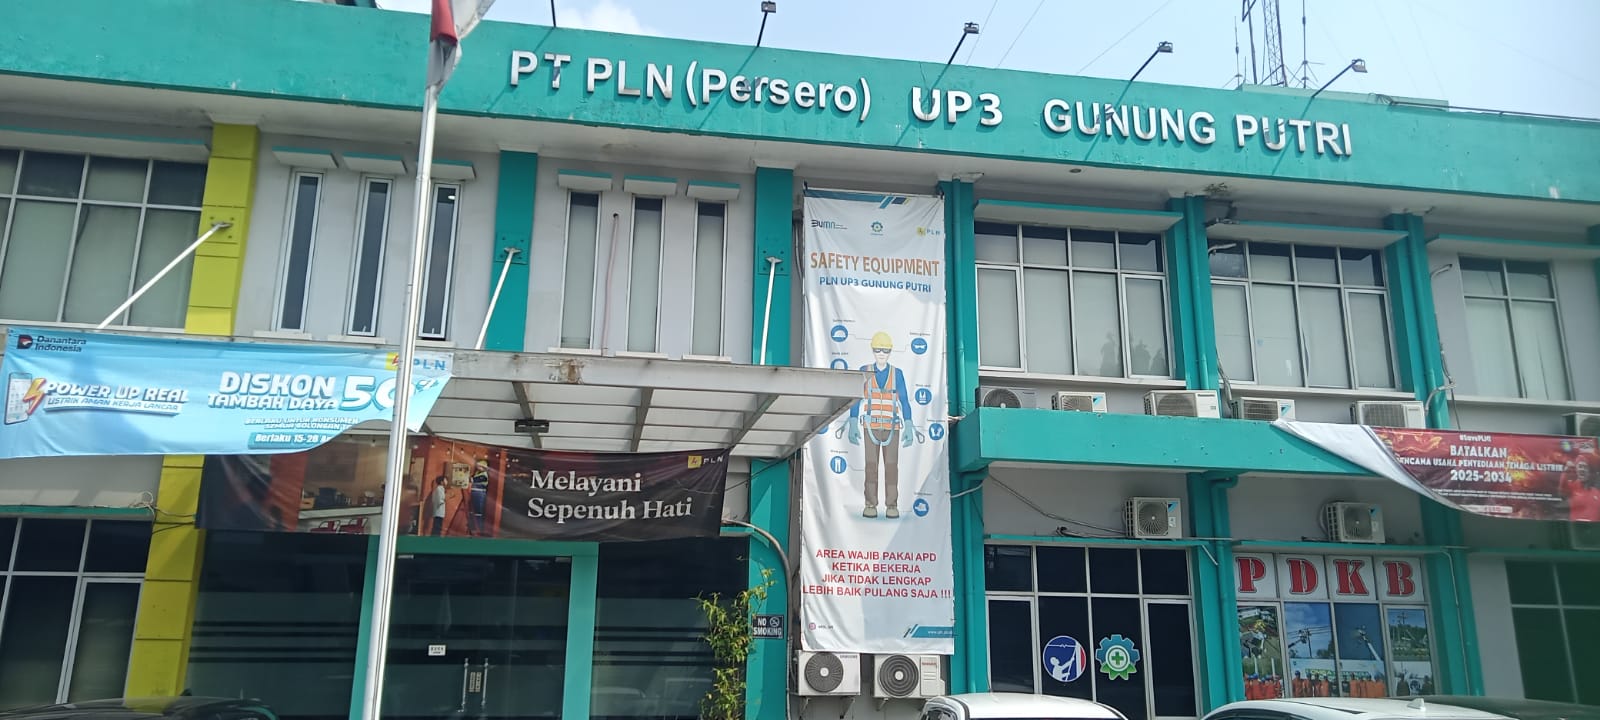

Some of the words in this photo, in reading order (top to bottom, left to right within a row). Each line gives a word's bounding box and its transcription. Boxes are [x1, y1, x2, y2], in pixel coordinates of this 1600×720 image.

[510, 50, 571, 89] PT
[586, 57, 674, 99] PLN
[685, 60, 872, 122] (Persero)
[911, 86, 1004, 126] UP3
[1042, 98, 1217, 145] GUNUNG
[1234, 113, 1353, 156] PUTRI
[810, 252, 860, 271] SAFETY
[863, 256, 940, 277] EQUIPMENT
[819, 277, 838, 286] PLN
[840, 279, 859, 287] UP3
[861, 279, 904, 290] GUNUNG
[905, 281, 931, 293] PUTRI
[36, 335, 87, 345] Danantara
[35, 343, 82, 353] Indonesia
[219, 371, 337, 400] DISKON
[45, 382, 111, 399] POWER
[114, 386, 141, 400] UP
[143, 388, 189, 403] REAL
[47, 397, 79, 406] LISTRIK
[81, 398, 111, 406] AMAN
[207, 393, 285, 411] TAMBAH
[287, 398, 340, 411] DAYA
[255, 433, 291, 443] Berlaku
[1450, 445, 1507, 458] BATALKAN
[703, 455, 724, 465] PLN
[1433, 459, 1457, 467] USAHA
[1506, 461, 1535, 471] TENAGA
[1450, 469, 1513, 484] 2025-2034
[530, 469, 641, 497] Melayani
[527, 497, 635, 524] Sepenuh
[643, 496, 692, 519] Hati
[816, 549, 845, 559] AREA
[848, 550, 879, 560] WAJIB
[882, 551, 914, 561] PAKAI
[915, 552, 937, 562] APD
[832, 562, 870, 572] KETIKA
[873, 563, 921, 573] BEKERJA
[822, 574, 845, 584] JIKA
[848, 575, 879, 585] TIDAK
[882, 576, 931, 586] LENGKAP
[802, 586, 833, 595] LEBIH
[837, 587, 861, 596] BAIK
[864, 588, 908, 598] PULANG
[911, 589, 938, 598] SAJA
[757, 618, 767, 626] NO
[753, 627, 782, 636] SMOKING
